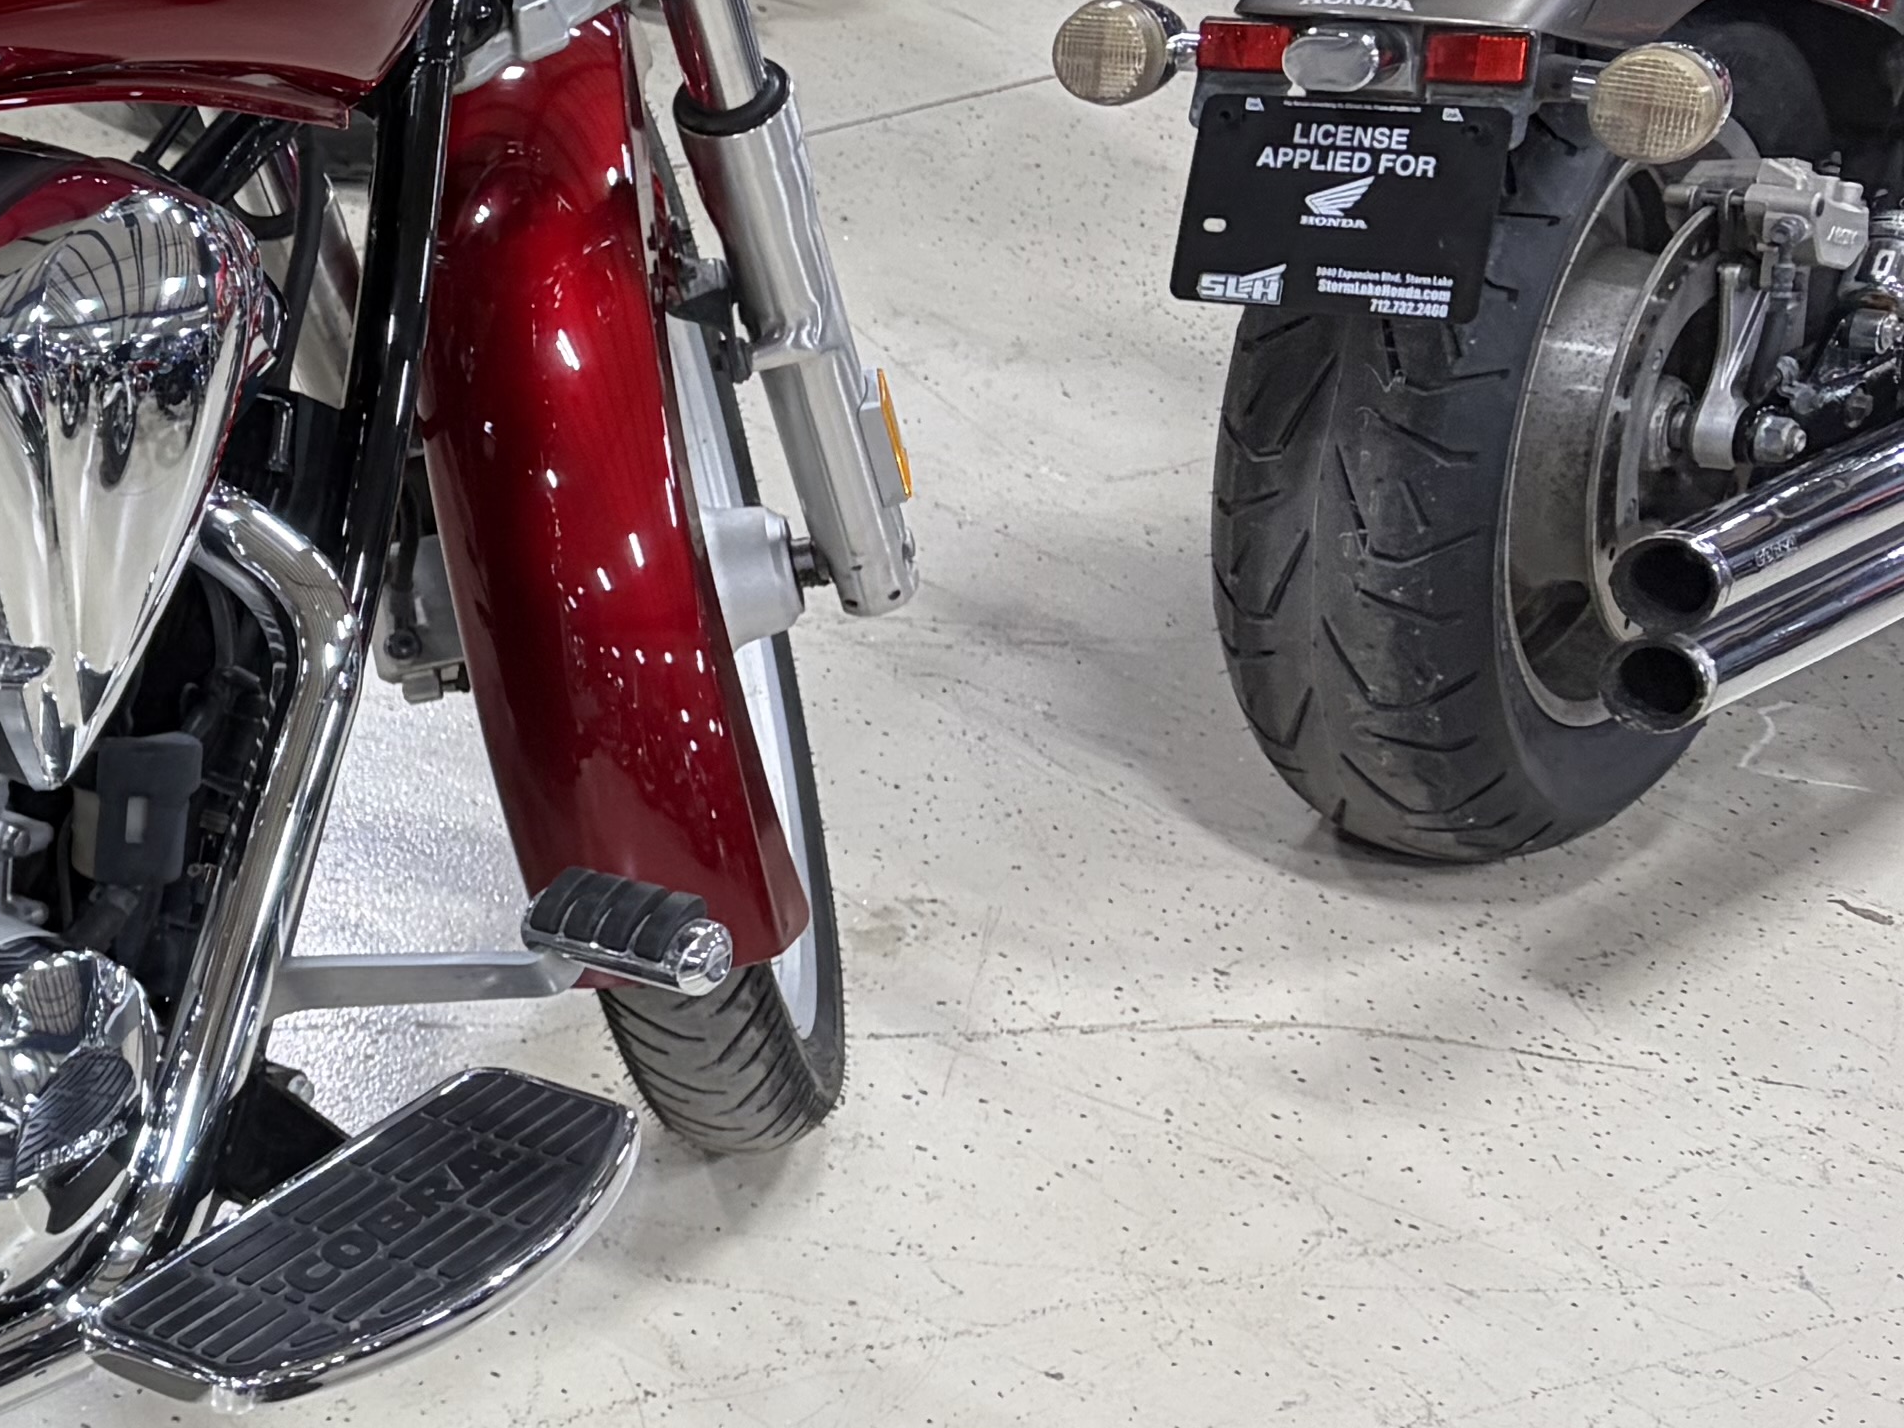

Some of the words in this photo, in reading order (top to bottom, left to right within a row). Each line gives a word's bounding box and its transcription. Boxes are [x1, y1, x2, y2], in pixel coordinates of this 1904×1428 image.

[1293, 122, 1410, 150] LICENSE
[1256, 146, 1372, 174] APPLIED
[1378, 153, 1437, 178] FOR
[1299, 215, 1368, 229] HONDA
[283, 1145, 512, 1294] COBRA
